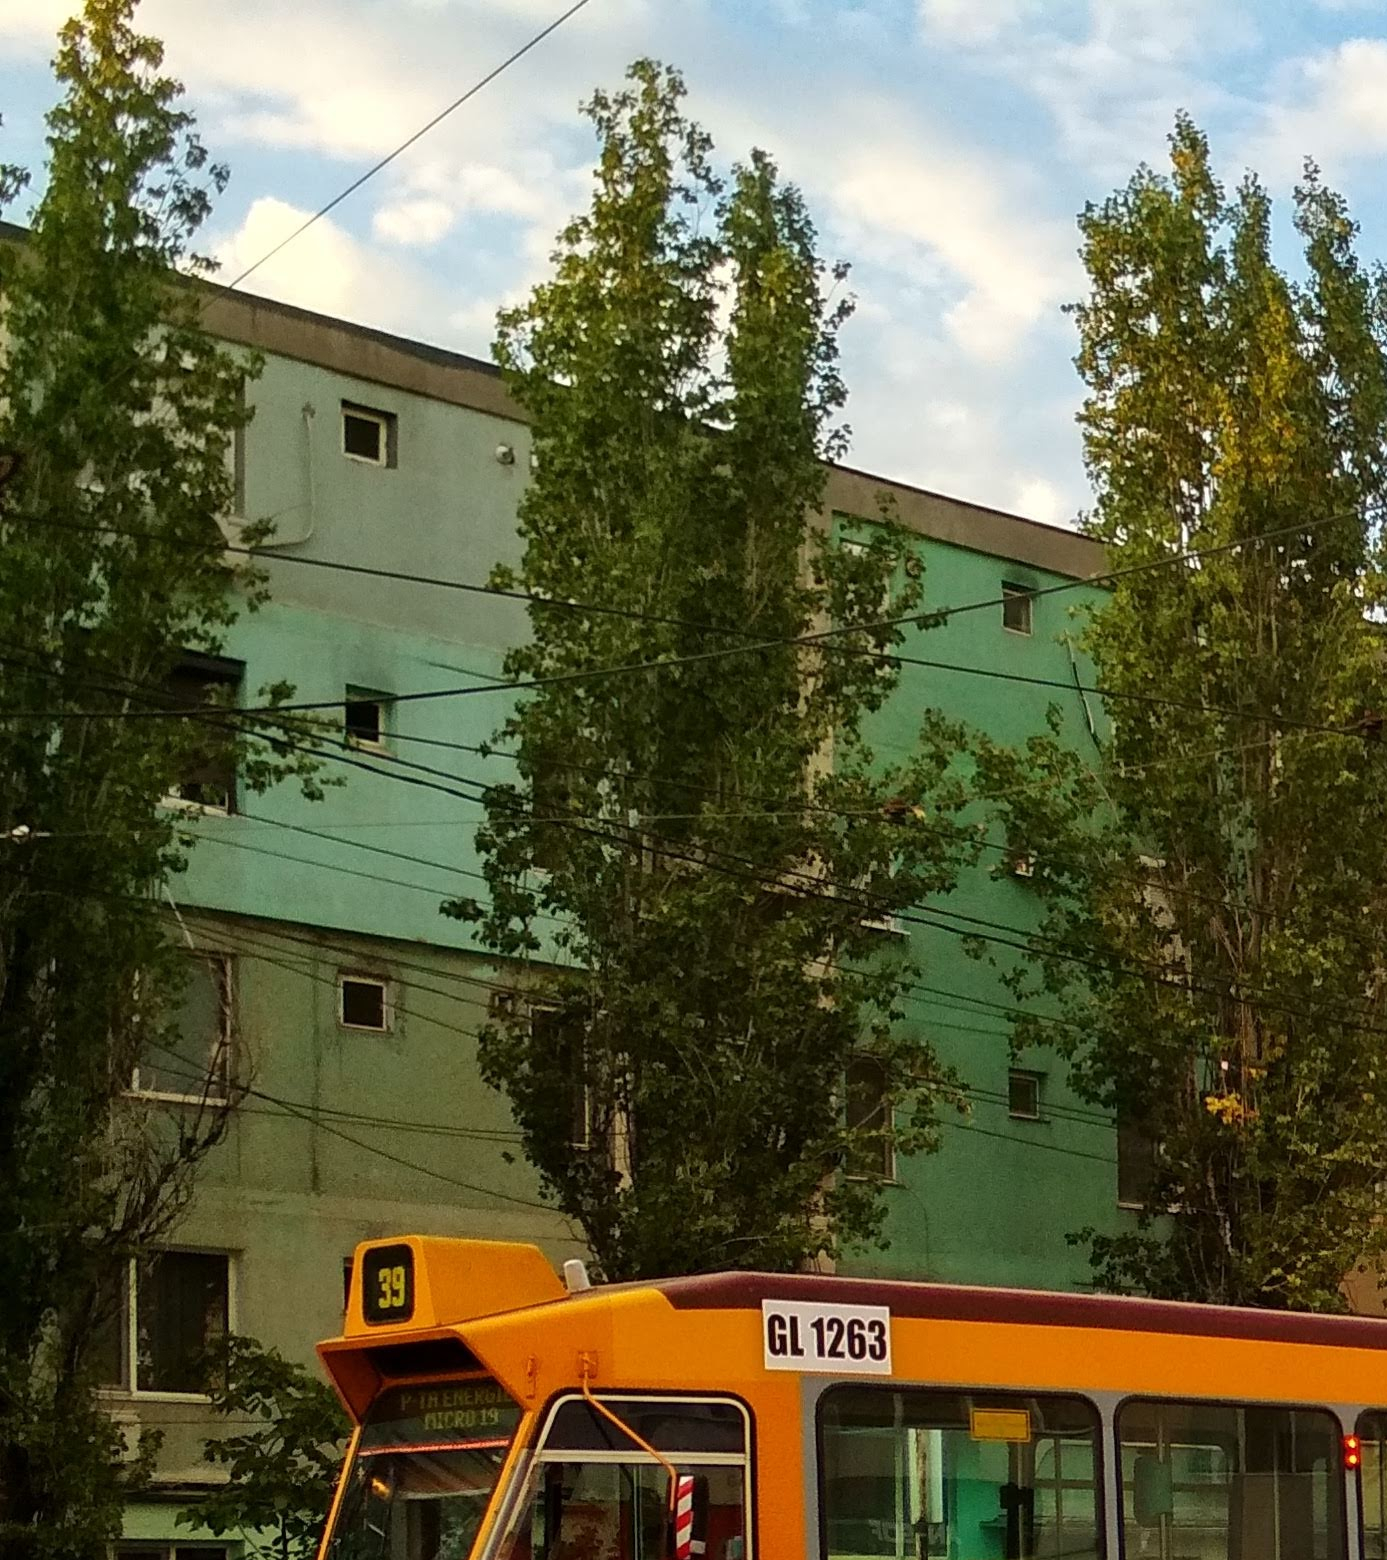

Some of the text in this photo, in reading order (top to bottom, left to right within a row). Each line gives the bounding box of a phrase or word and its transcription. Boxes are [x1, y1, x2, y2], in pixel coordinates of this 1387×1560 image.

[378, 1265, 406, 1309] 39
[767, 1313, 887, 1361] GL 1263
[424, 1407, 499, 1431] MICRO 19
